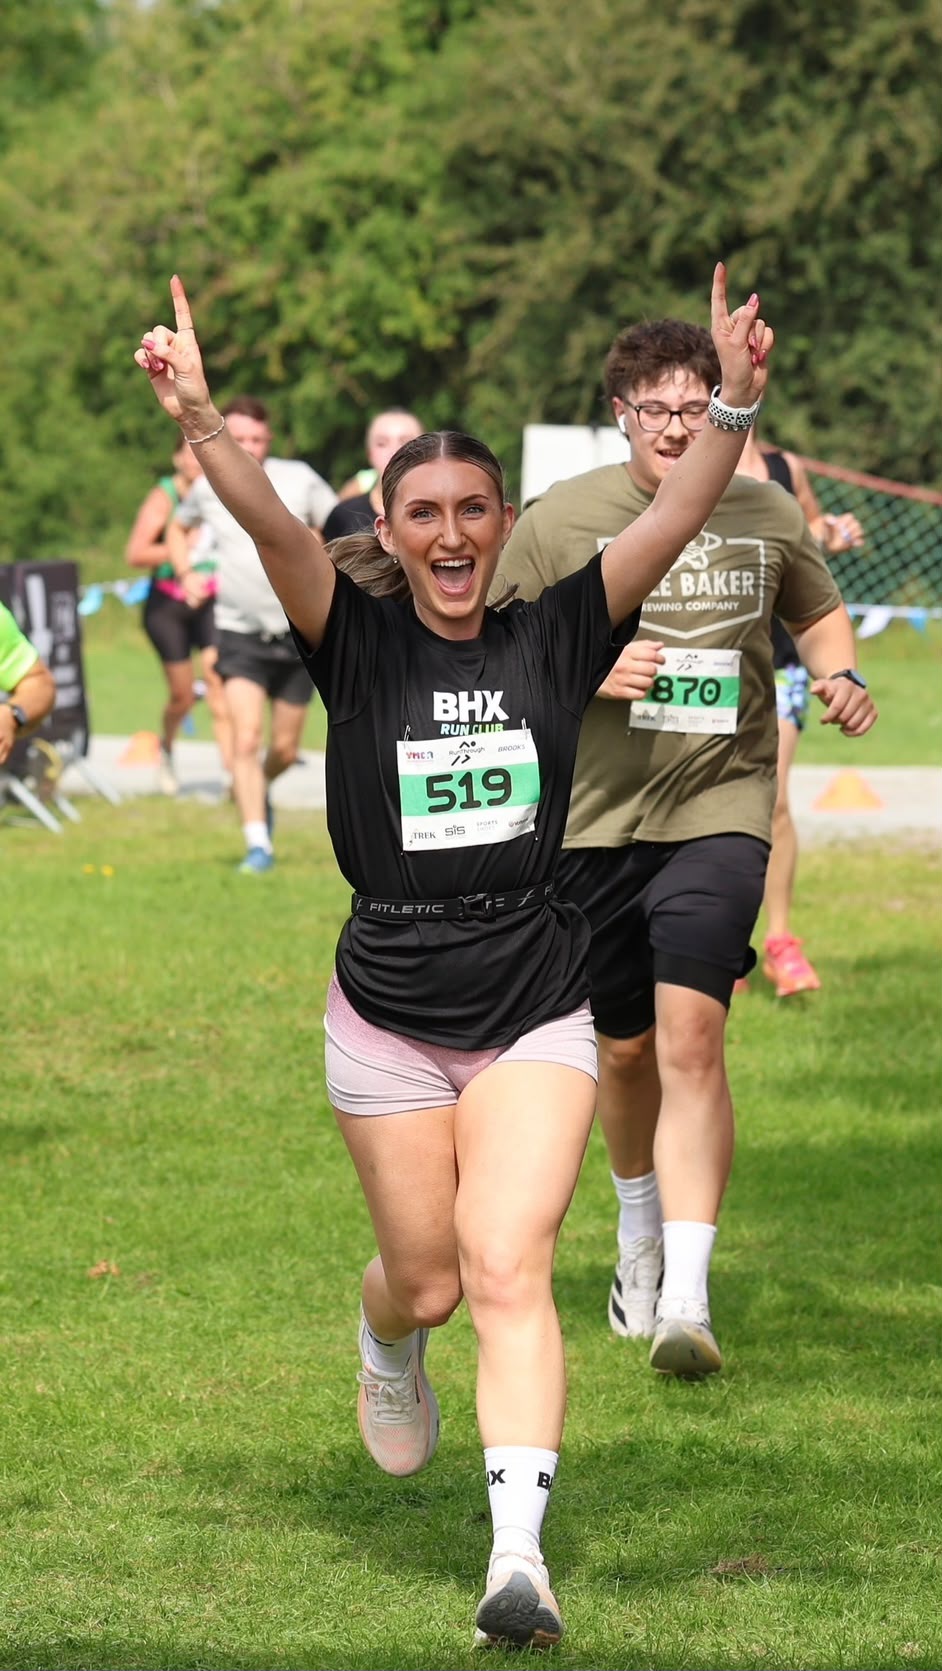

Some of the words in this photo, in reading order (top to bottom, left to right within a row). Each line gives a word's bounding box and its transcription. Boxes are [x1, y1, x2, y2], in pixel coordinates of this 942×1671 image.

[680, 570, 754, 597] BAKER
[685, 601, 739, 612] COMPANY
[652, 676, 721, 706] 870
[433, 690, 510, 722] BHX
[440, 723, 470, 736] RUN
[472, 723, 504, 735] CLUB
[498, 744, 525, 753] BROOKS
[426, 768, 512, 813] 519
[476, 819, 499, 828] SPORTS
[412, 831, 436, 840] TREK
[369, 903, 445, 914] FITLETIC
